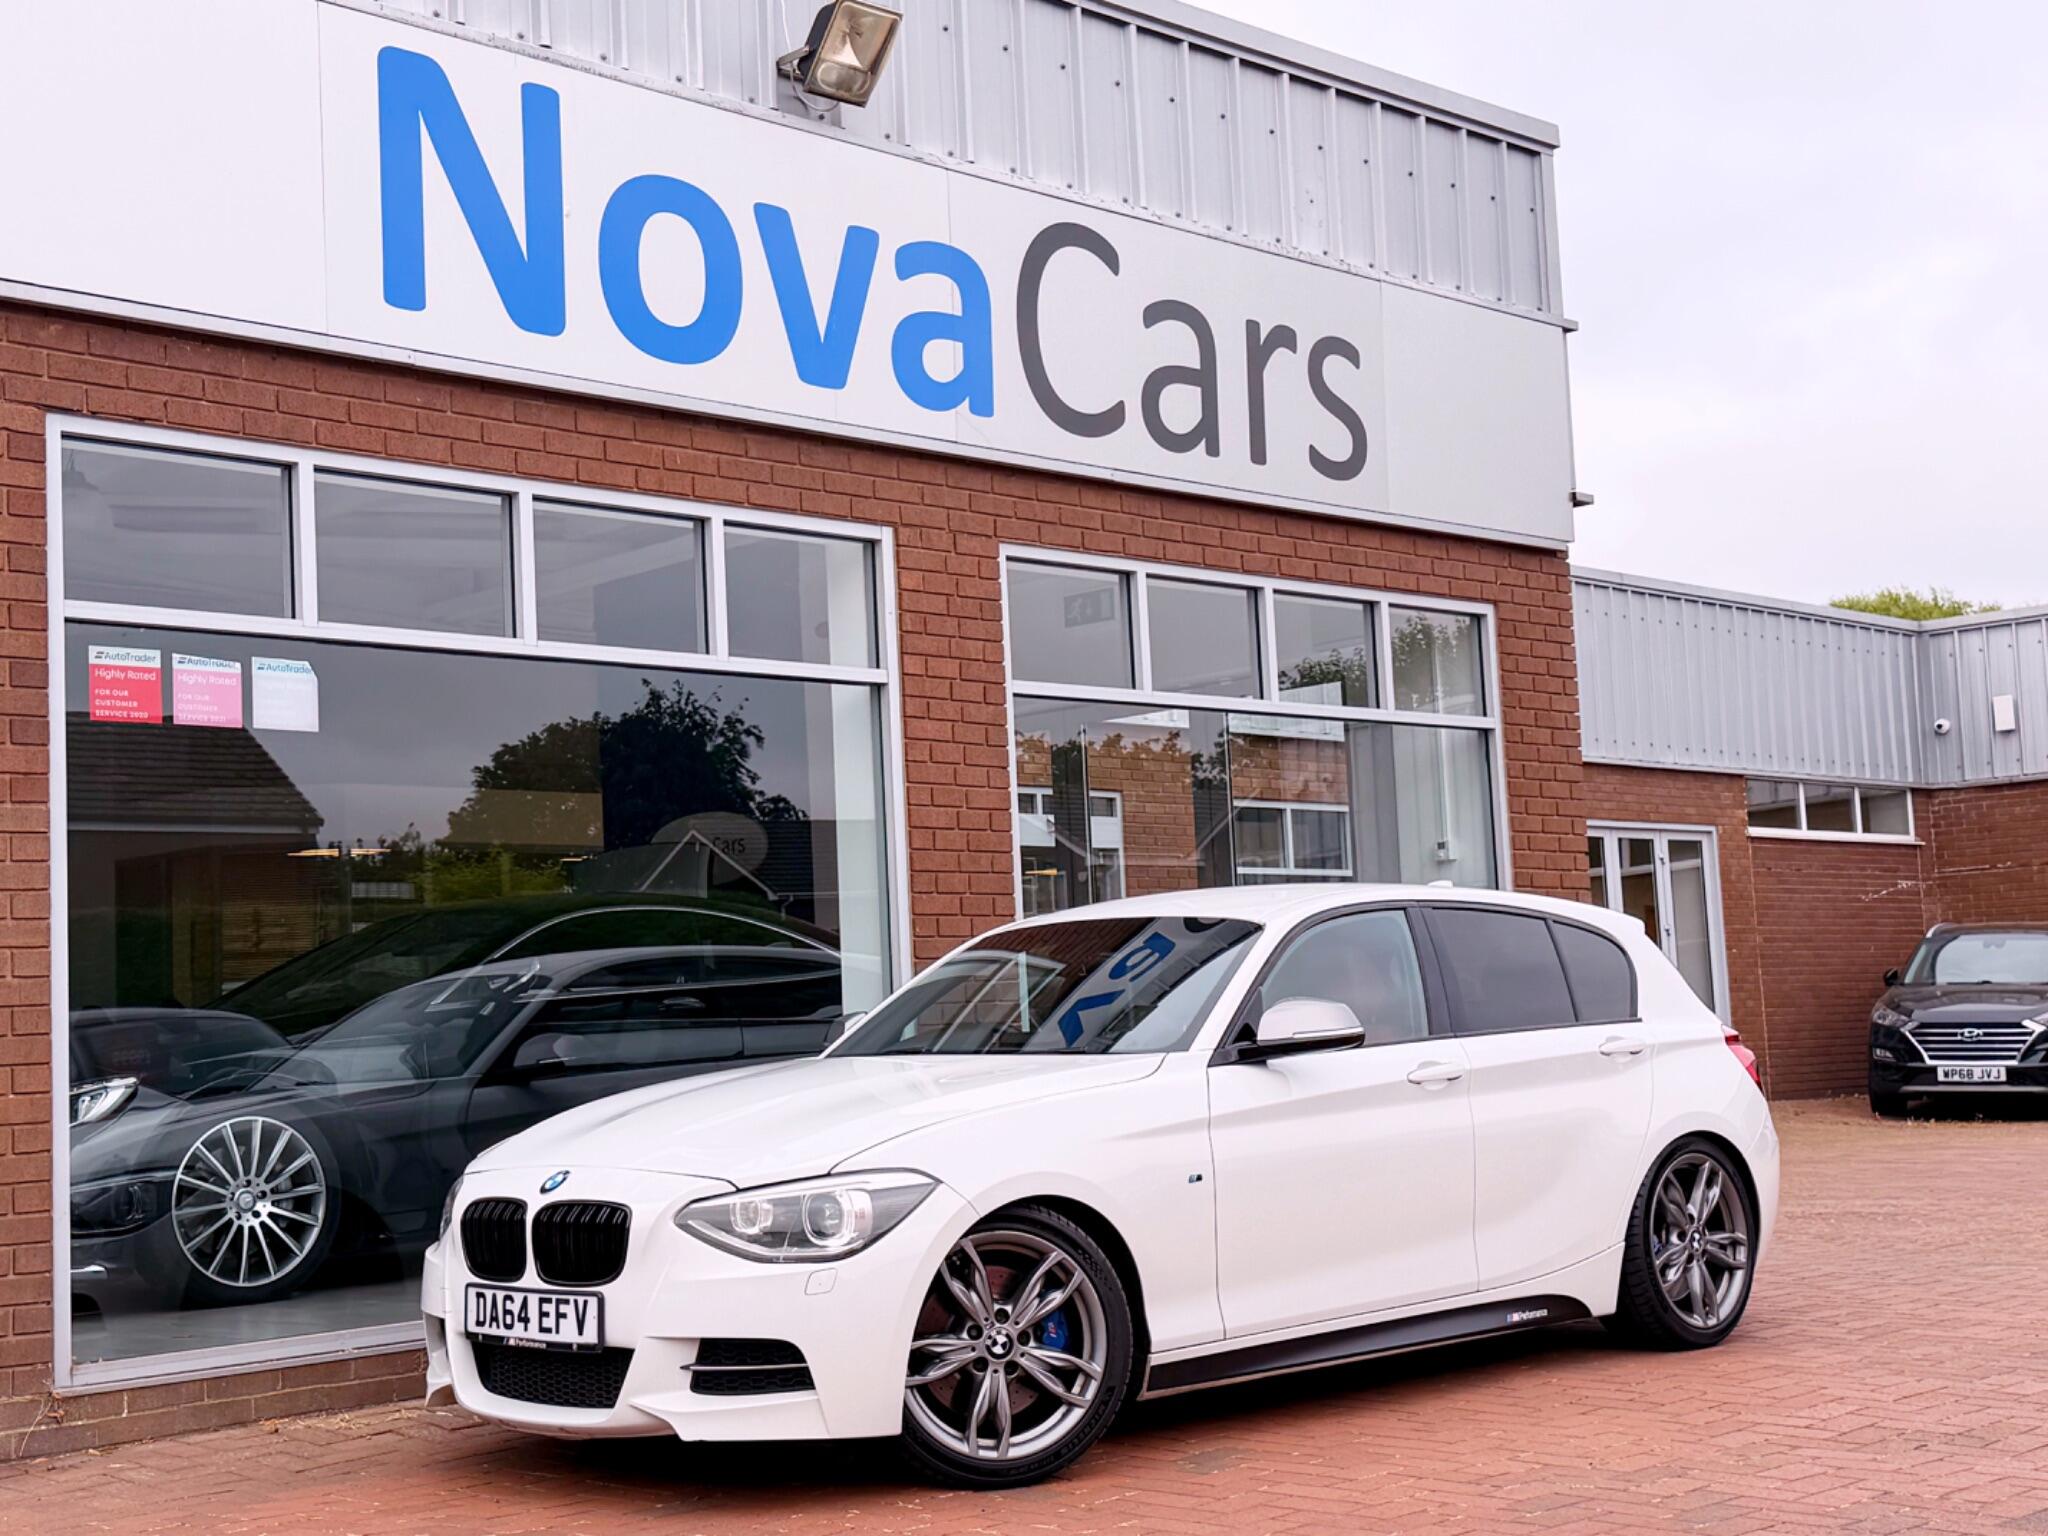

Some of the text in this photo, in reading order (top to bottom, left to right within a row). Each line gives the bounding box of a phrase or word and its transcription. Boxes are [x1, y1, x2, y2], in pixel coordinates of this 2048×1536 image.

[377, 45, 1370, 481] NovaCars
[104, 652, 157, 663] AutoTrader
[95, 667, 156, 681] Highly Rated
[112, 689, 129, 697] OUR
[95, 699, 138, 708] CUSTOMER
[95, 709, 128, 718] SERVICE
[1977, 1068, 2000, 1080] JVJ
[476, 1292, 589, 1336] DA64 EFV
